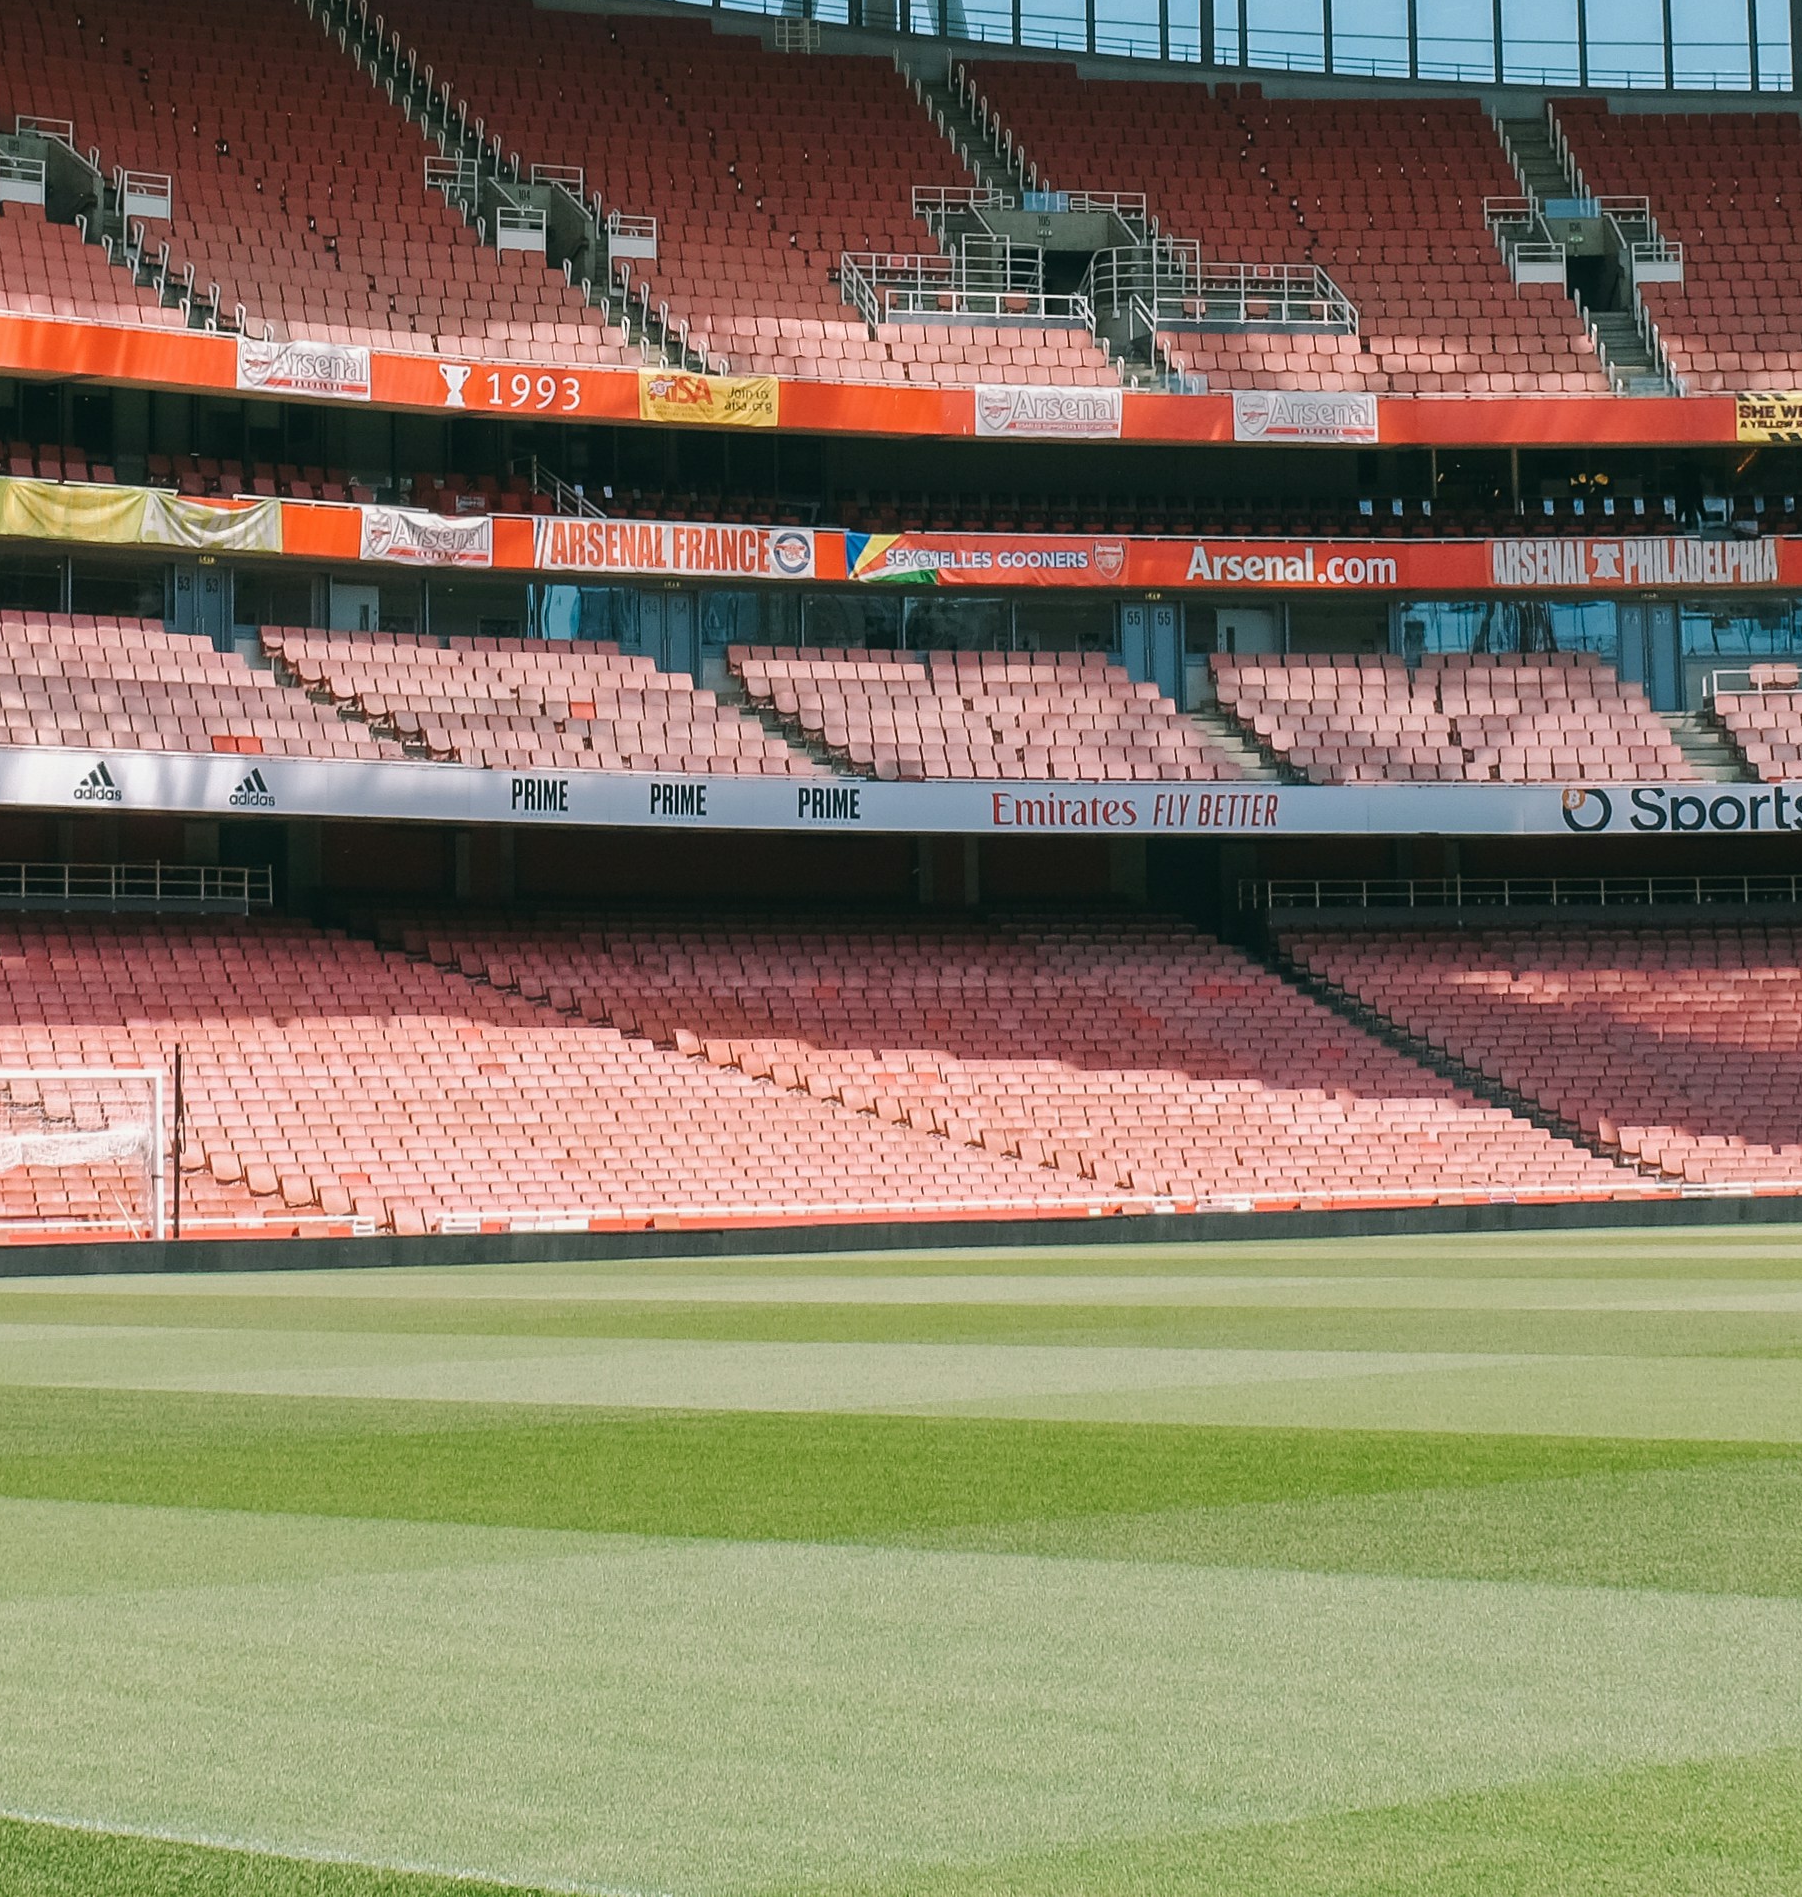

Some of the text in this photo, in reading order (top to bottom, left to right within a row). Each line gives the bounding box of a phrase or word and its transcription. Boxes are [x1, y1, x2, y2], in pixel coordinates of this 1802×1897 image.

[271, 350, 369, 382] Arsenal
[487, 372, 581, 411] 1993
[1012, 390, 1120, 420] Arsenal
[1270, 395, 1375, 426] Arsenal
[1738, 404, 1775, 419] SHE
[392, 513, 490, 551] Arsenal
[550, 522, 771, 573] ARSENAL FRANCE
[414, 549, 460, 561] CAMBOA
[885, 549, 1089, 569] SEYCHELLES GOONERS
[1186, 545, 1397, 584] Arsenal.com
[1492, 538, 1778, 585] ARSENAL PHILADELPHIA
[177, 576, 191, 592] 53
[205, 577, 218, 594] 53
[73, 784, 122, 801] adidas
[229, 790, 276, 807] adidas
[511, 778, 569, 812] PRIME
[650, 783, 707, 816] PRIME
[798, 786, 861, 820] PRIME
[992, 792, 1278, 827] Emirates FLY BETTER
